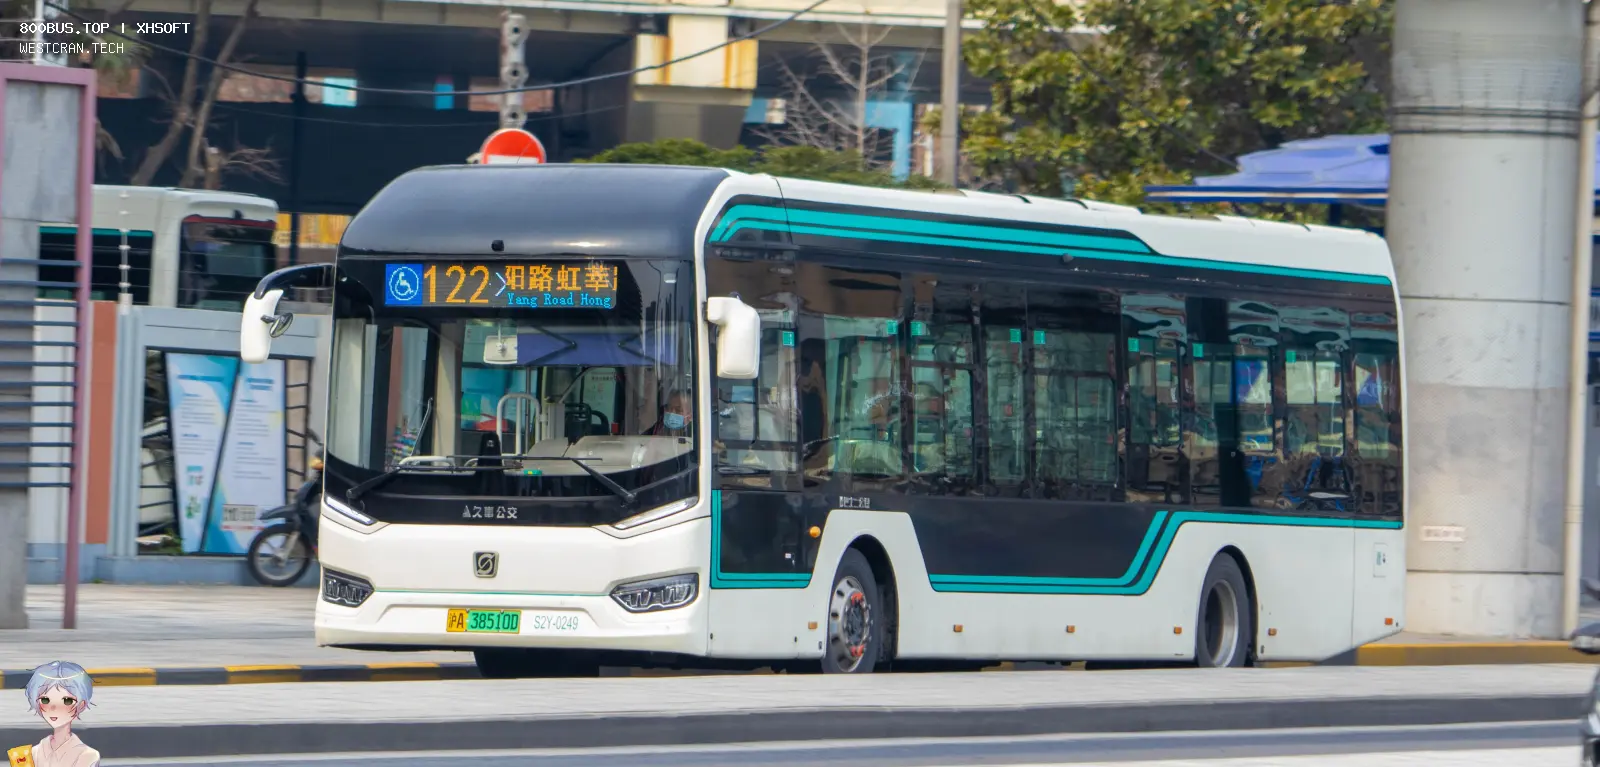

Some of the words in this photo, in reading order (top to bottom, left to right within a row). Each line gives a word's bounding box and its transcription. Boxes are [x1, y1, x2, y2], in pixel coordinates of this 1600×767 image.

[423, 264, 490, 304] 122
[506, 292, 538, 308] Yang
[543, 291, 574, 306] Road
[580, 293, 612, 309] Hong
[533, 615, 579, 631] S2Y-0249
